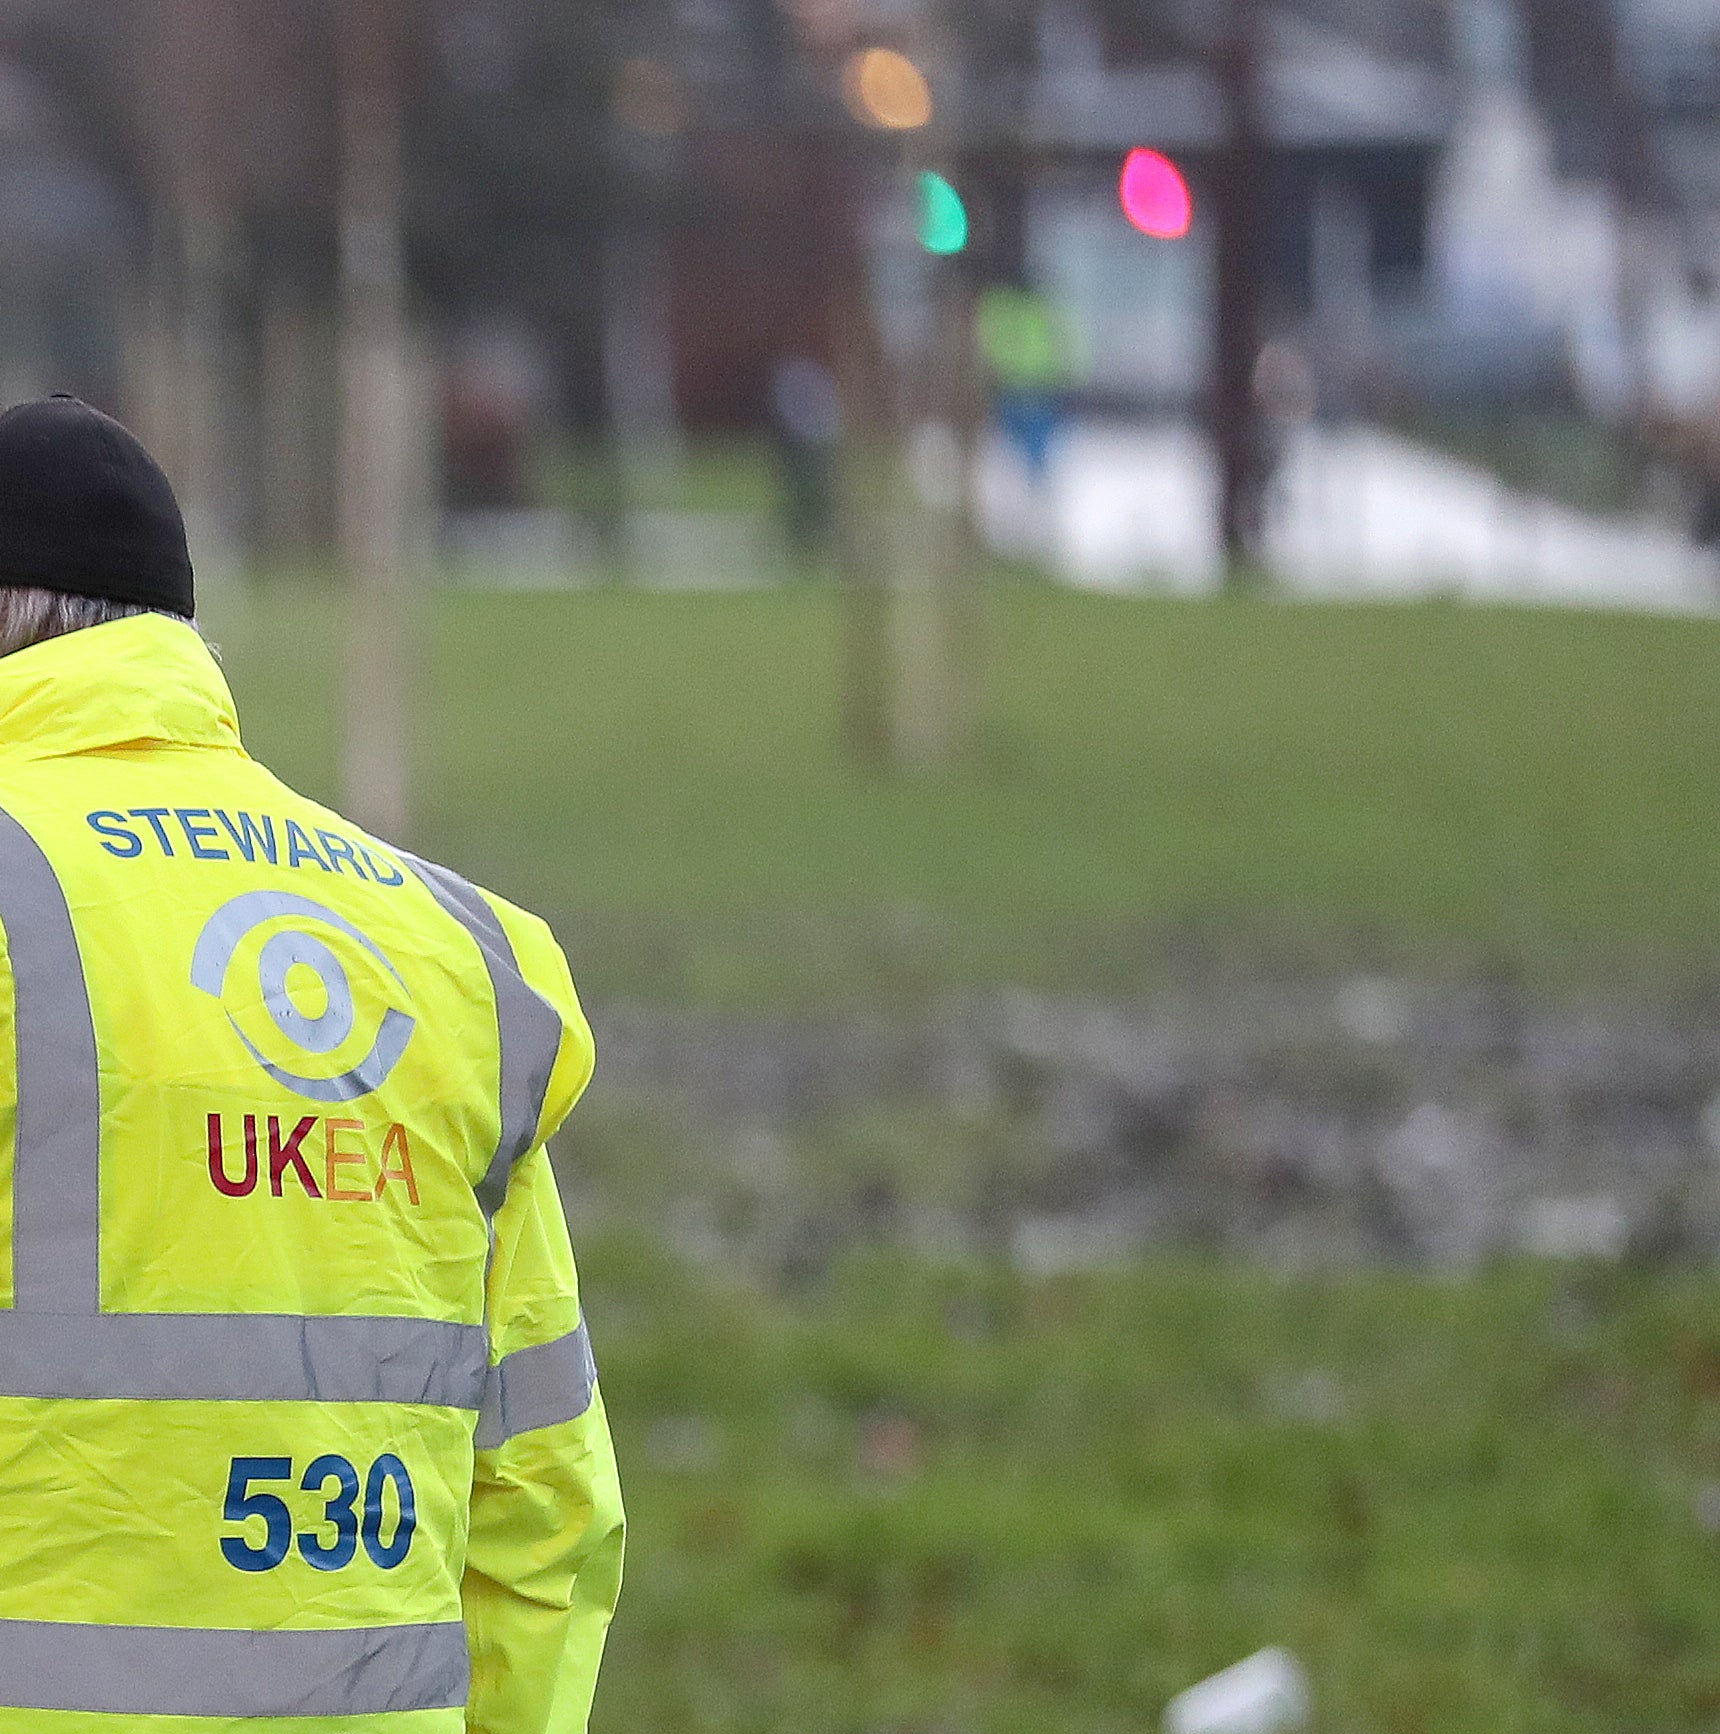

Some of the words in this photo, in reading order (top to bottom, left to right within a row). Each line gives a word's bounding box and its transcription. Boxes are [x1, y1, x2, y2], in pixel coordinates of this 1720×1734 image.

[86, 808, 404, 888] STEWARD
[206, 1112, 420, 1206] UKEA
[218, 1452, 418, 1573] 530
